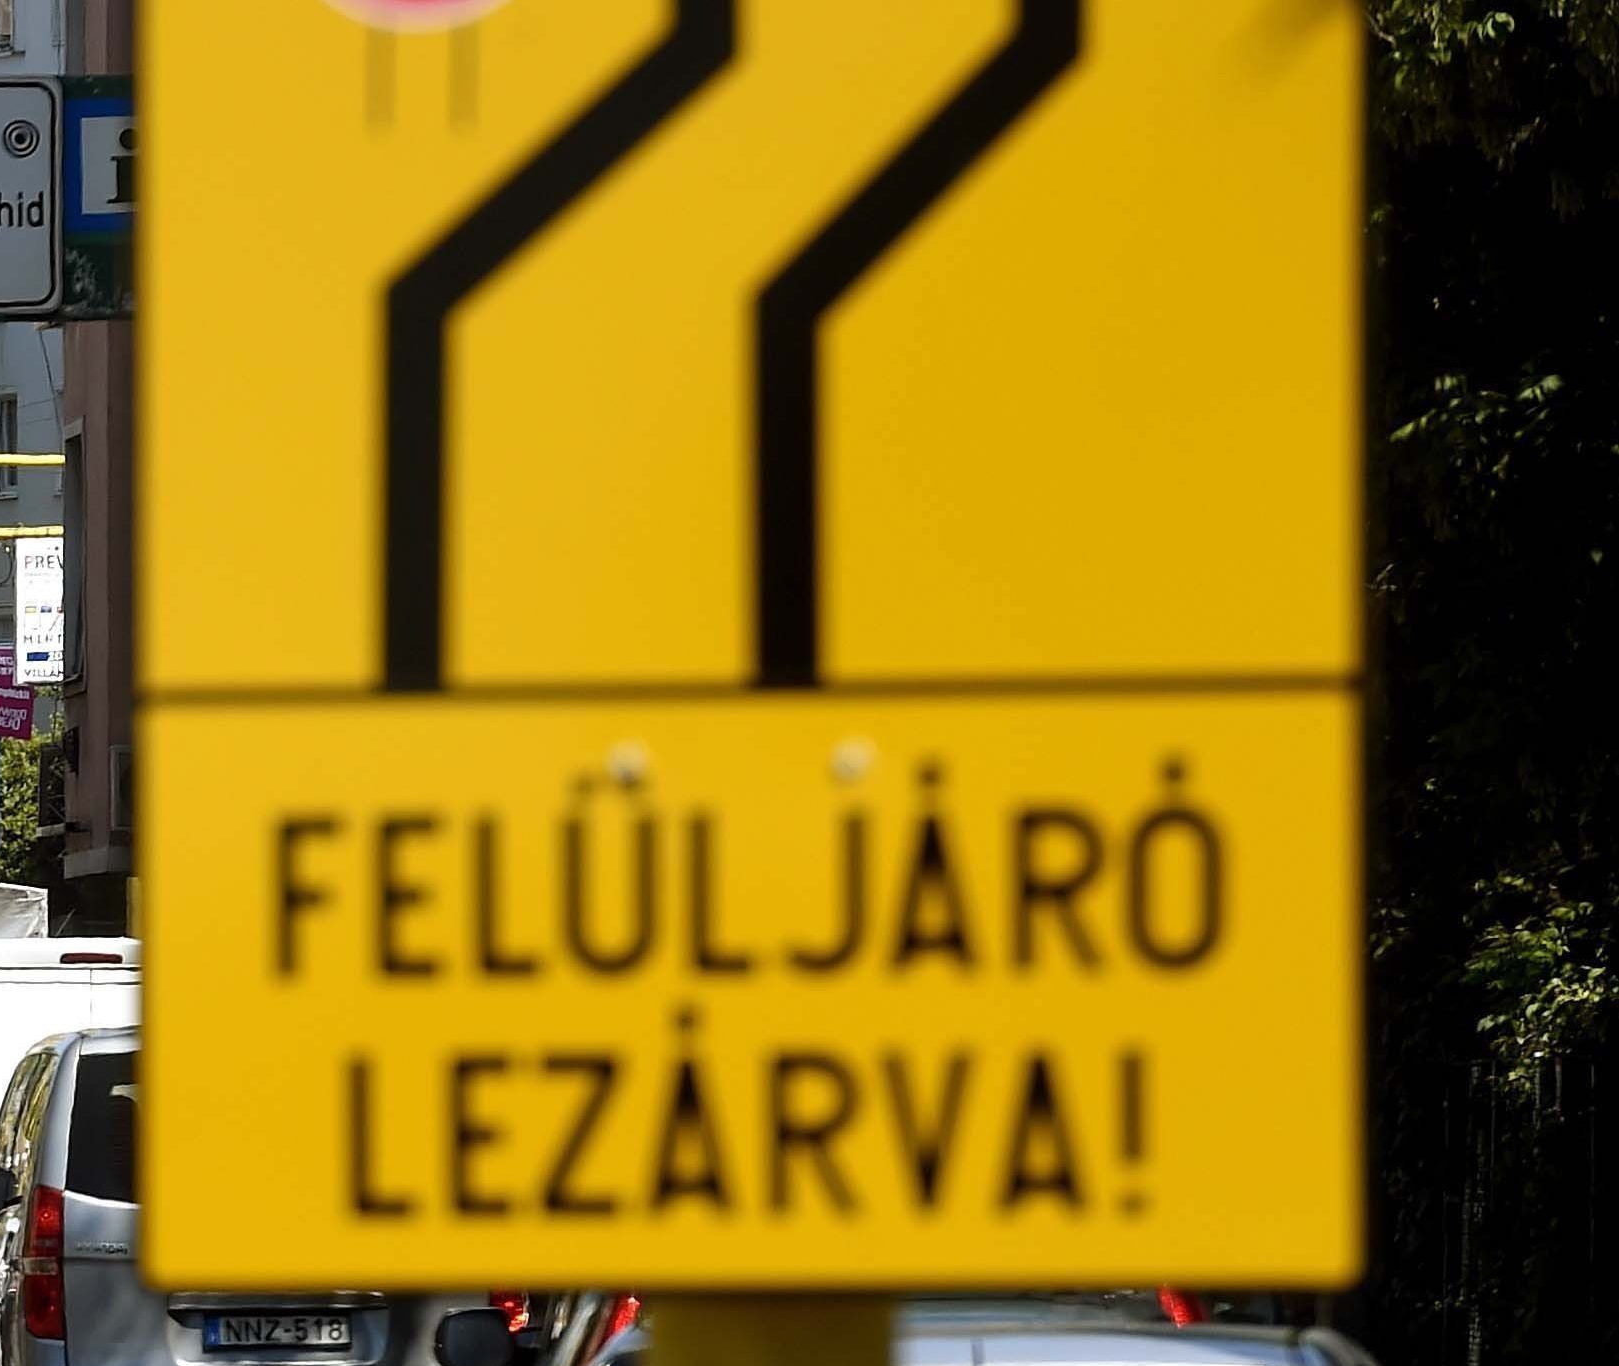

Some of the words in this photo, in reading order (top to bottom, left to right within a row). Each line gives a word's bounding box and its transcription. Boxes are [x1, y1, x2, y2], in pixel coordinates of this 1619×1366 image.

[269, 752, 1234, 984] FELÜLJÁRÓ
[347, 1001, 1150, 1220] LEZÁRVA!
[225, 1318, 344, 1343] NNZ-518
